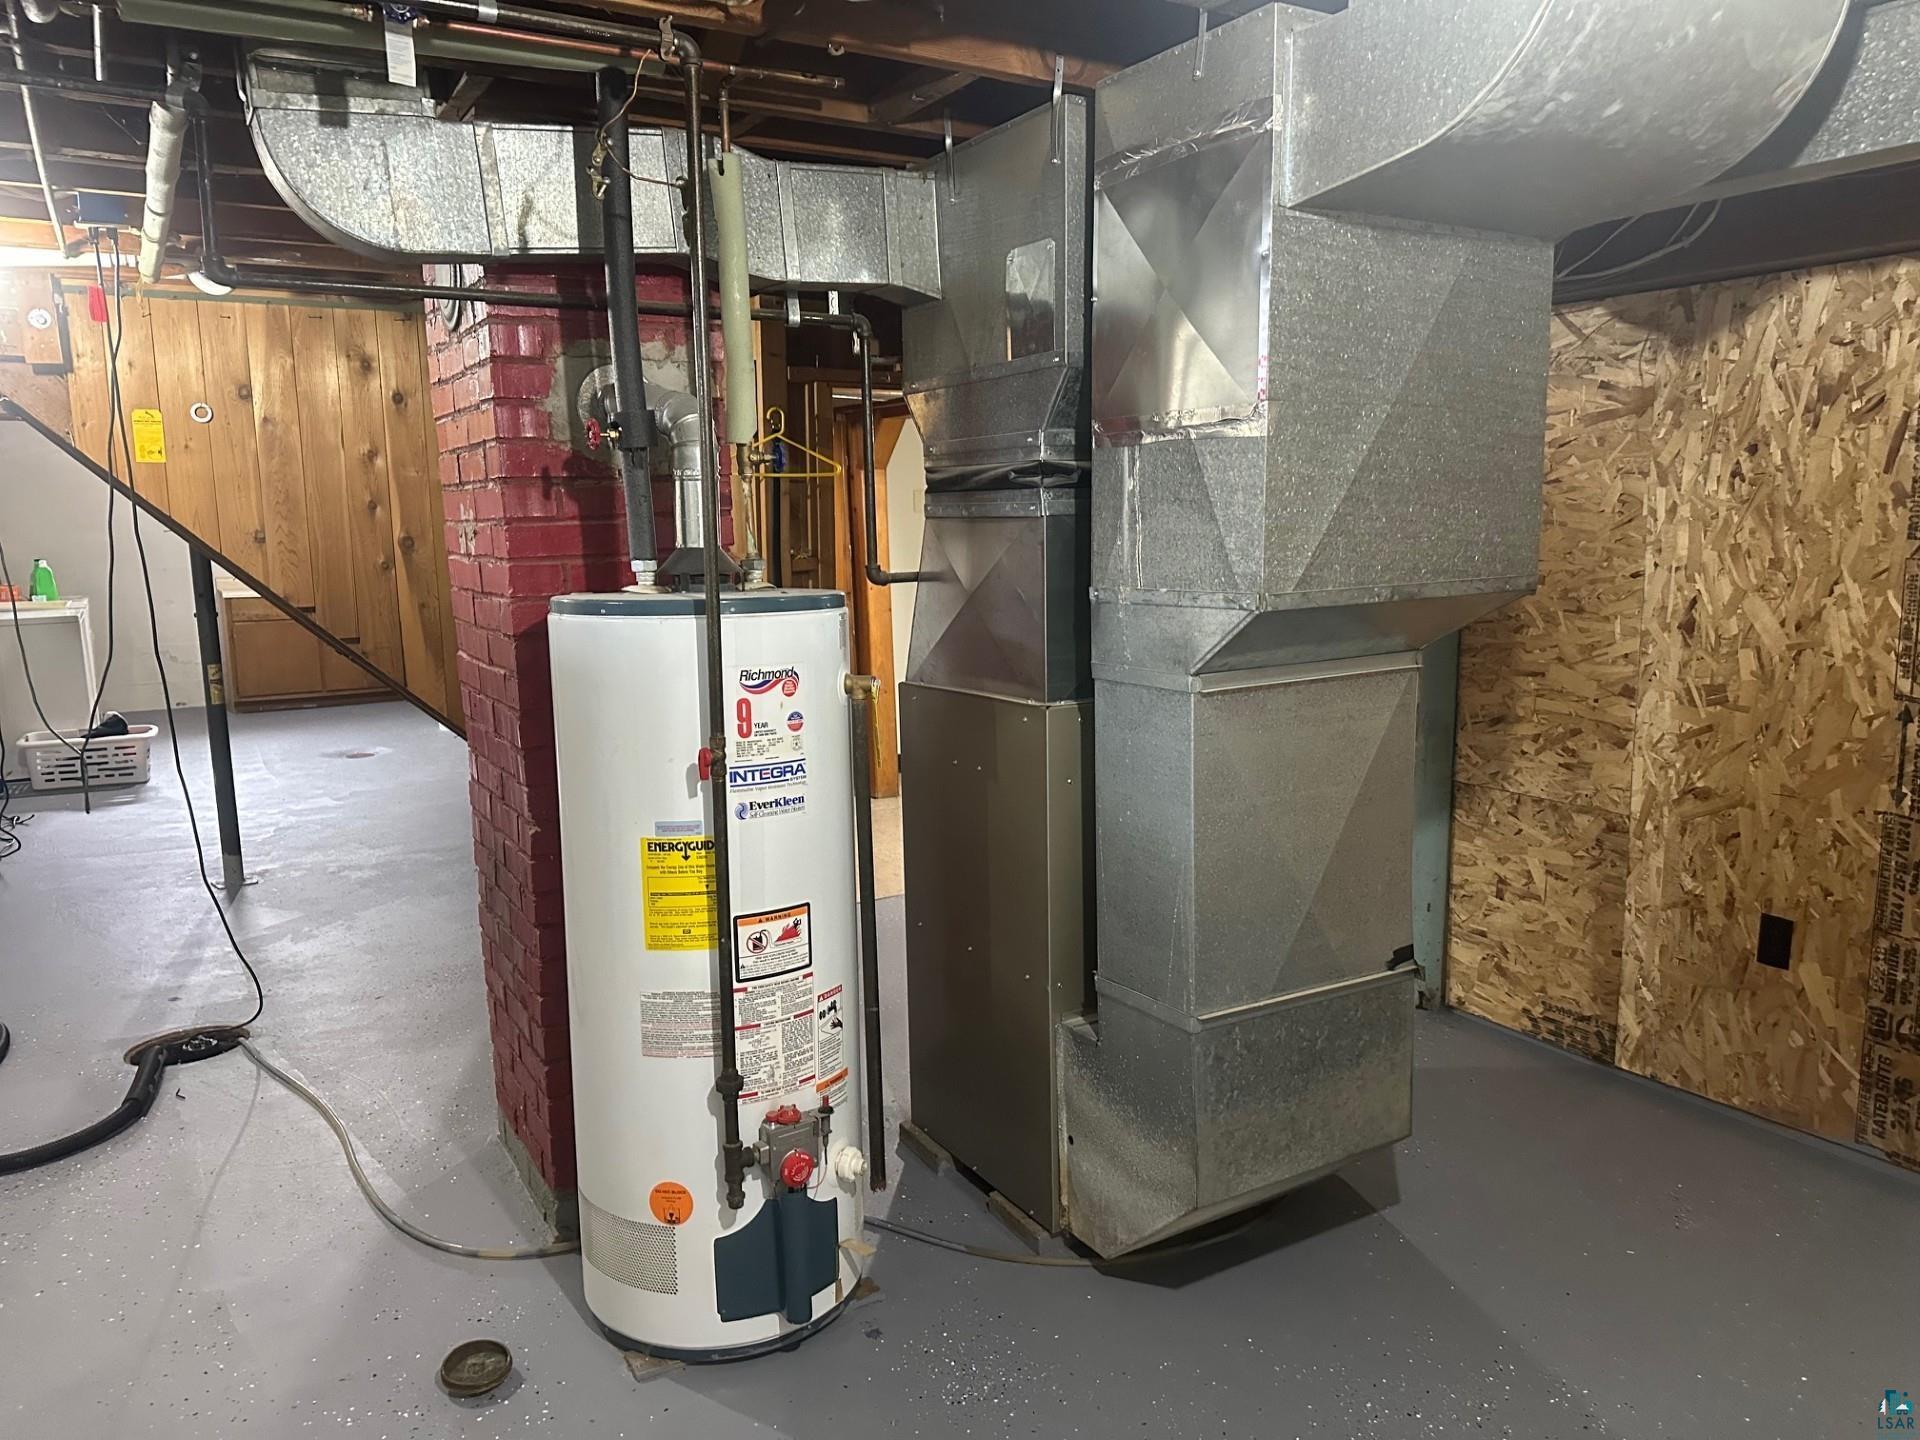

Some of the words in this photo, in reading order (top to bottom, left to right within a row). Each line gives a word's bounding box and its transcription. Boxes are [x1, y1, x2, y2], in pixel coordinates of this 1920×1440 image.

[739, 666, 794, 681] Richmond
[737, 698, 752, 738] 9
[729, 763, 806, 783] INTEGRA
[749, 796, 804, 810] EverKleen
[648, 840, 715, 854] ENERGYGUID
[1871, 1093, 1888, 1139] RATED
